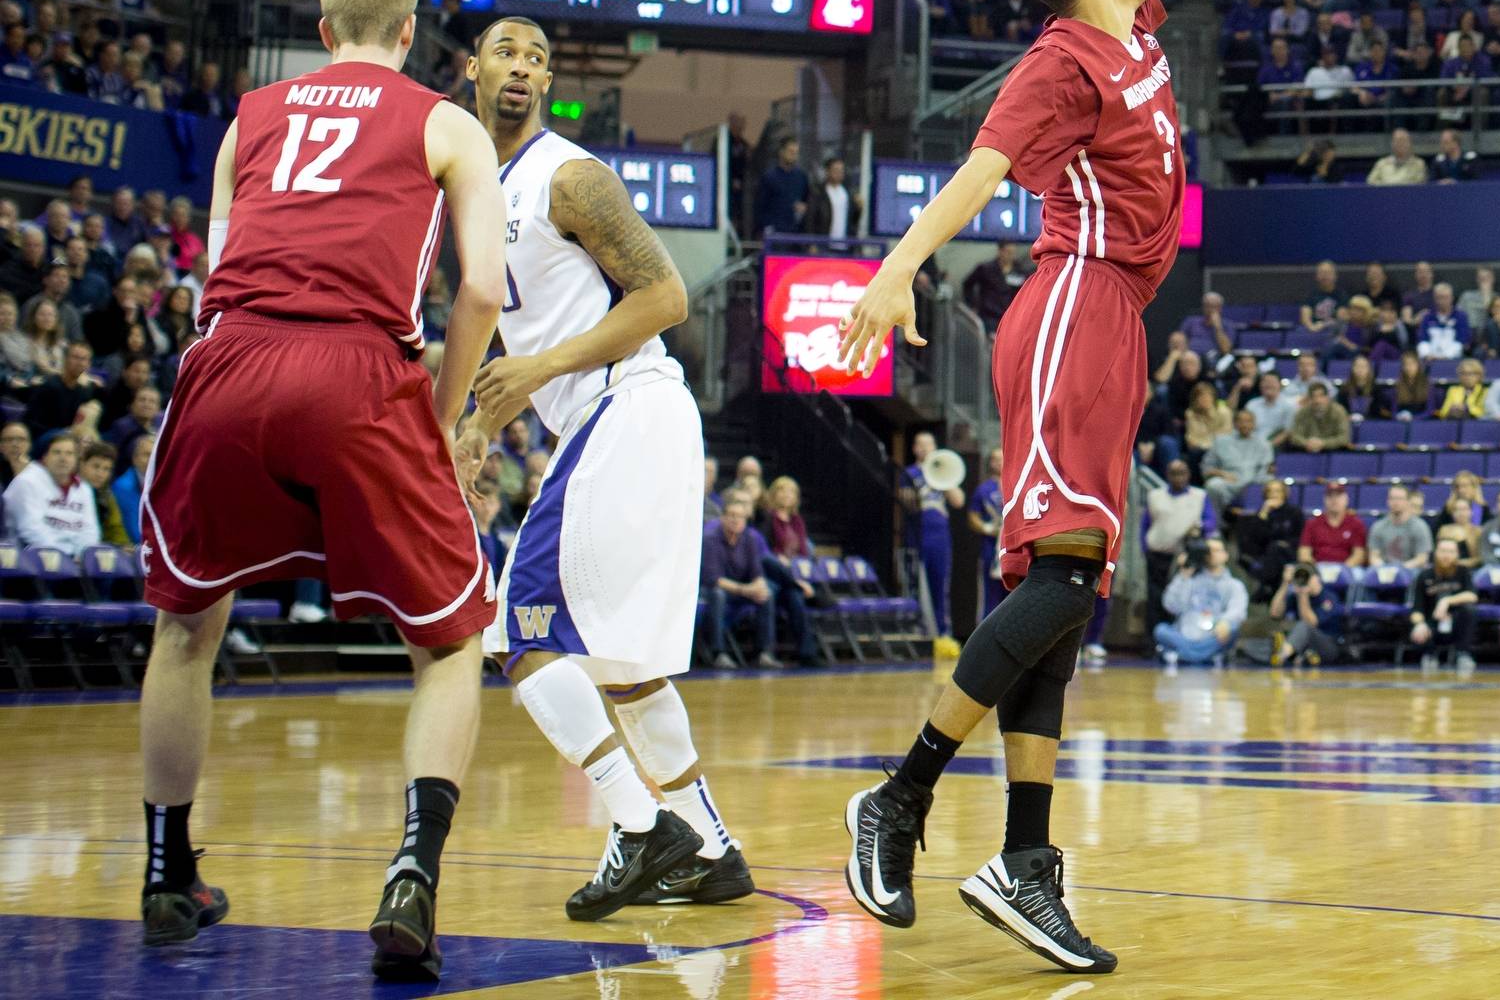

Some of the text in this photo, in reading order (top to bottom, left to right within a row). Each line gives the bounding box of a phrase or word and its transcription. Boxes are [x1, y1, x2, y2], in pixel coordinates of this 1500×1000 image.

[284, 84, 383, 109] MOTUM
[271, 113, 360, 192] 12
[514, 605, 557, 640] W
